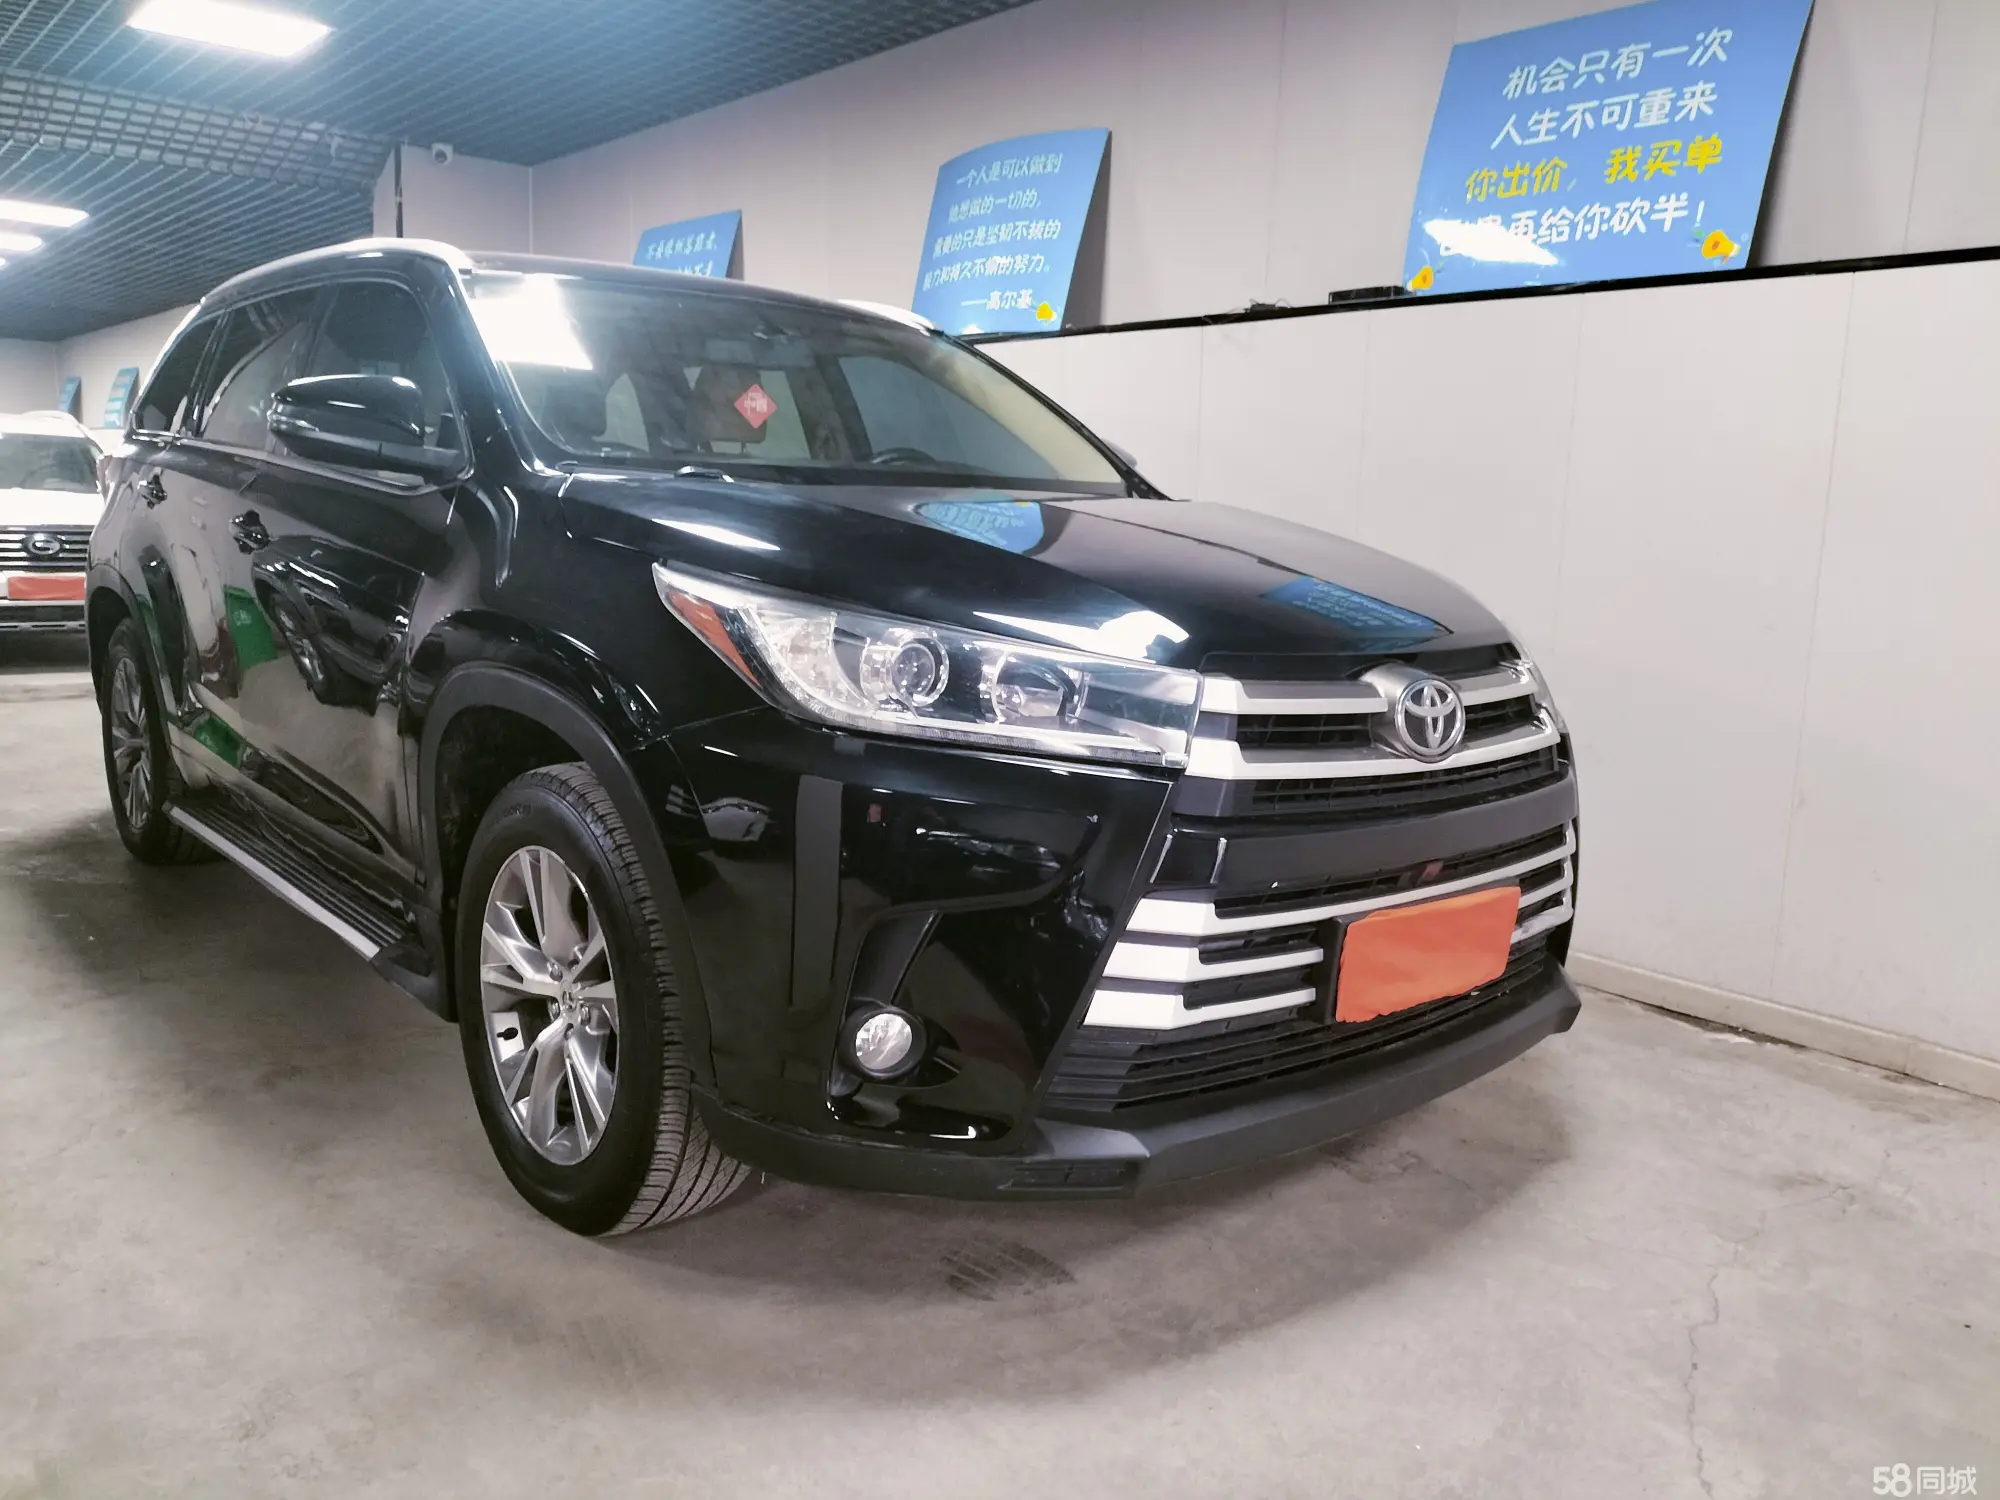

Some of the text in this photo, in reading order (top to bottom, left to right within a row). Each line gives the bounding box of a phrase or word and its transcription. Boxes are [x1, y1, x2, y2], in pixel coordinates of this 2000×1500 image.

[1502, 26, 1733, 100] 机会只有一次
[1490, 81, 1718, 150] 人生不可重来
[956, 152, 1063, 188] 一个人是可以做到
[1437, 192, 1705, 256] 再给你砍半！
